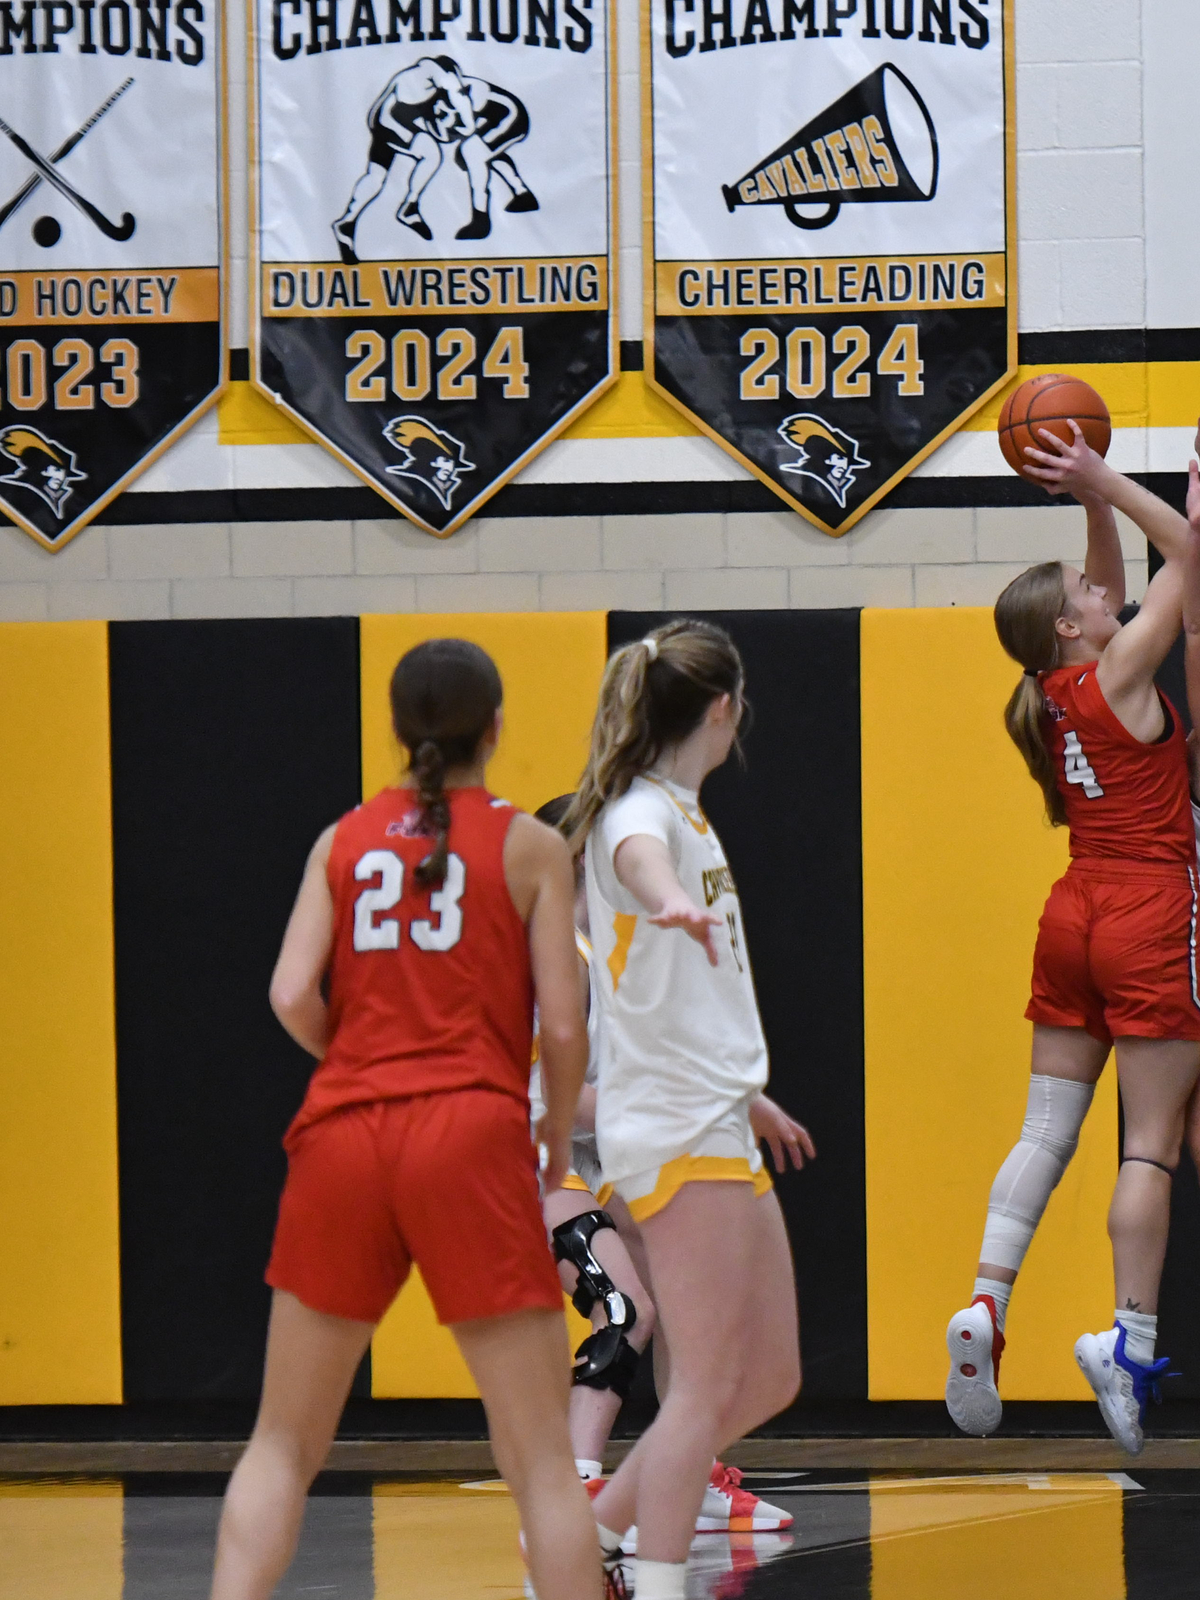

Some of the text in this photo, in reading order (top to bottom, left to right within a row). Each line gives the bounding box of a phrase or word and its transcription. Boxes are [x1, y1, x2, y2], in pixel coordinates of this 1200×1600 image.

[0, 0, 205, 66] MPIONS
[272, 0, 594, 61] CHAMPIONS
[664, 0, 991, 59] CHAMPIONS
[737, 115, 899, 203] CAVALIERS
[35, 275, 178, 318] HOCKEY
[270, 263, 600, 310] DUAL WRESTLING
[677, 260, 986, 308] CHEERLEADING
[0, 338, 140, 411] 023
[345, 327, 530, 402] 2024
[740, 324, 924, 400] 2024
[1062, 730, 1105, 800] 4
[352, 848, 467, 953] 23
